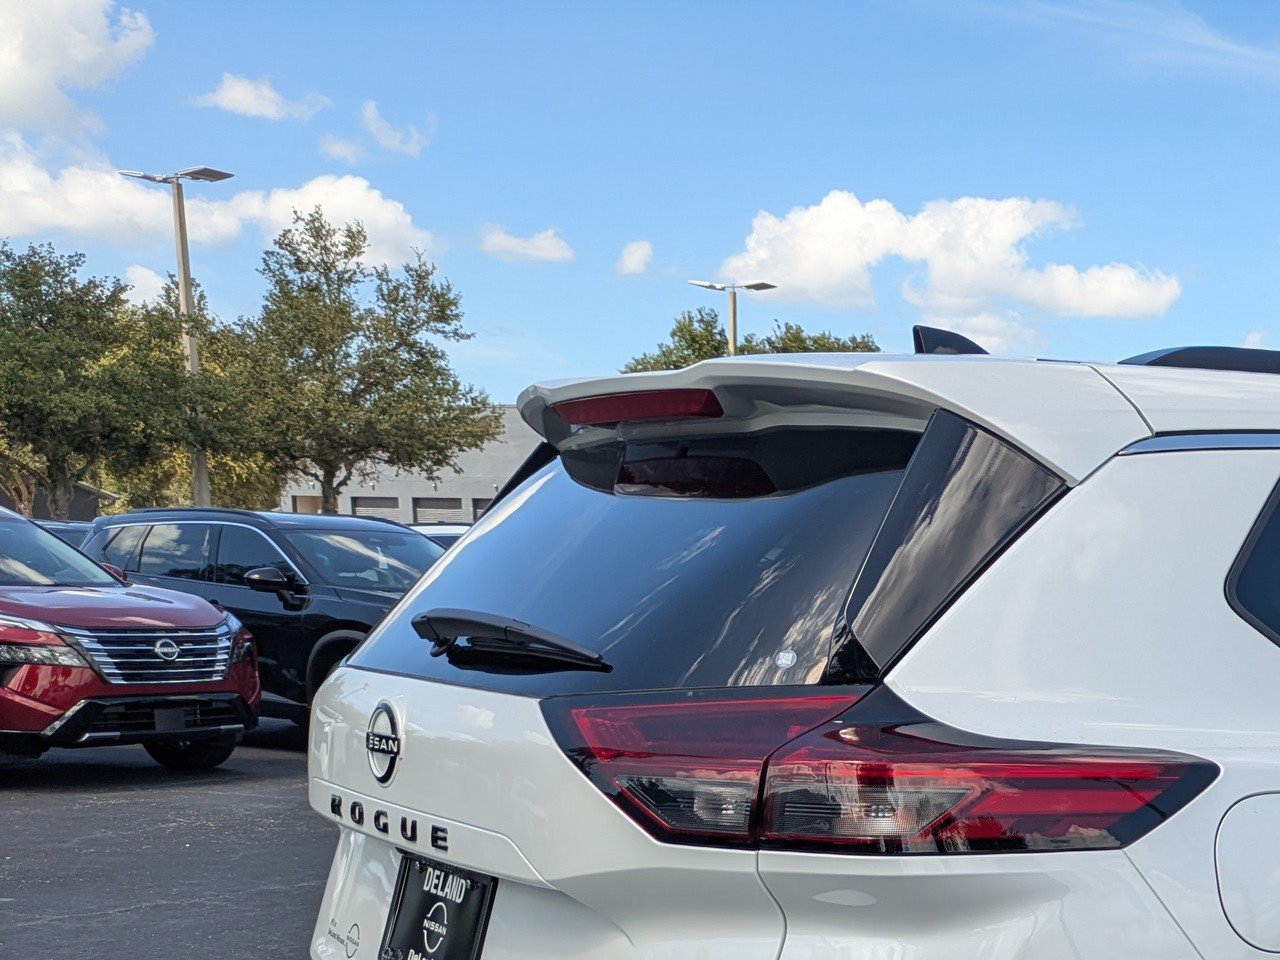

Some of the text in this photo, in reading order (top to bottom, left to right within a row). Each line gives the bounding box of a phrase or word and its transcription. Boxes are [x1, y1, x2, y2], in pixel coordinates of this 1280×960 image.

[331, 793, 448, 852] ROGUE
[423, 867, 466, 903] DELAND
[423, 919, 447, 936] NISSAN
